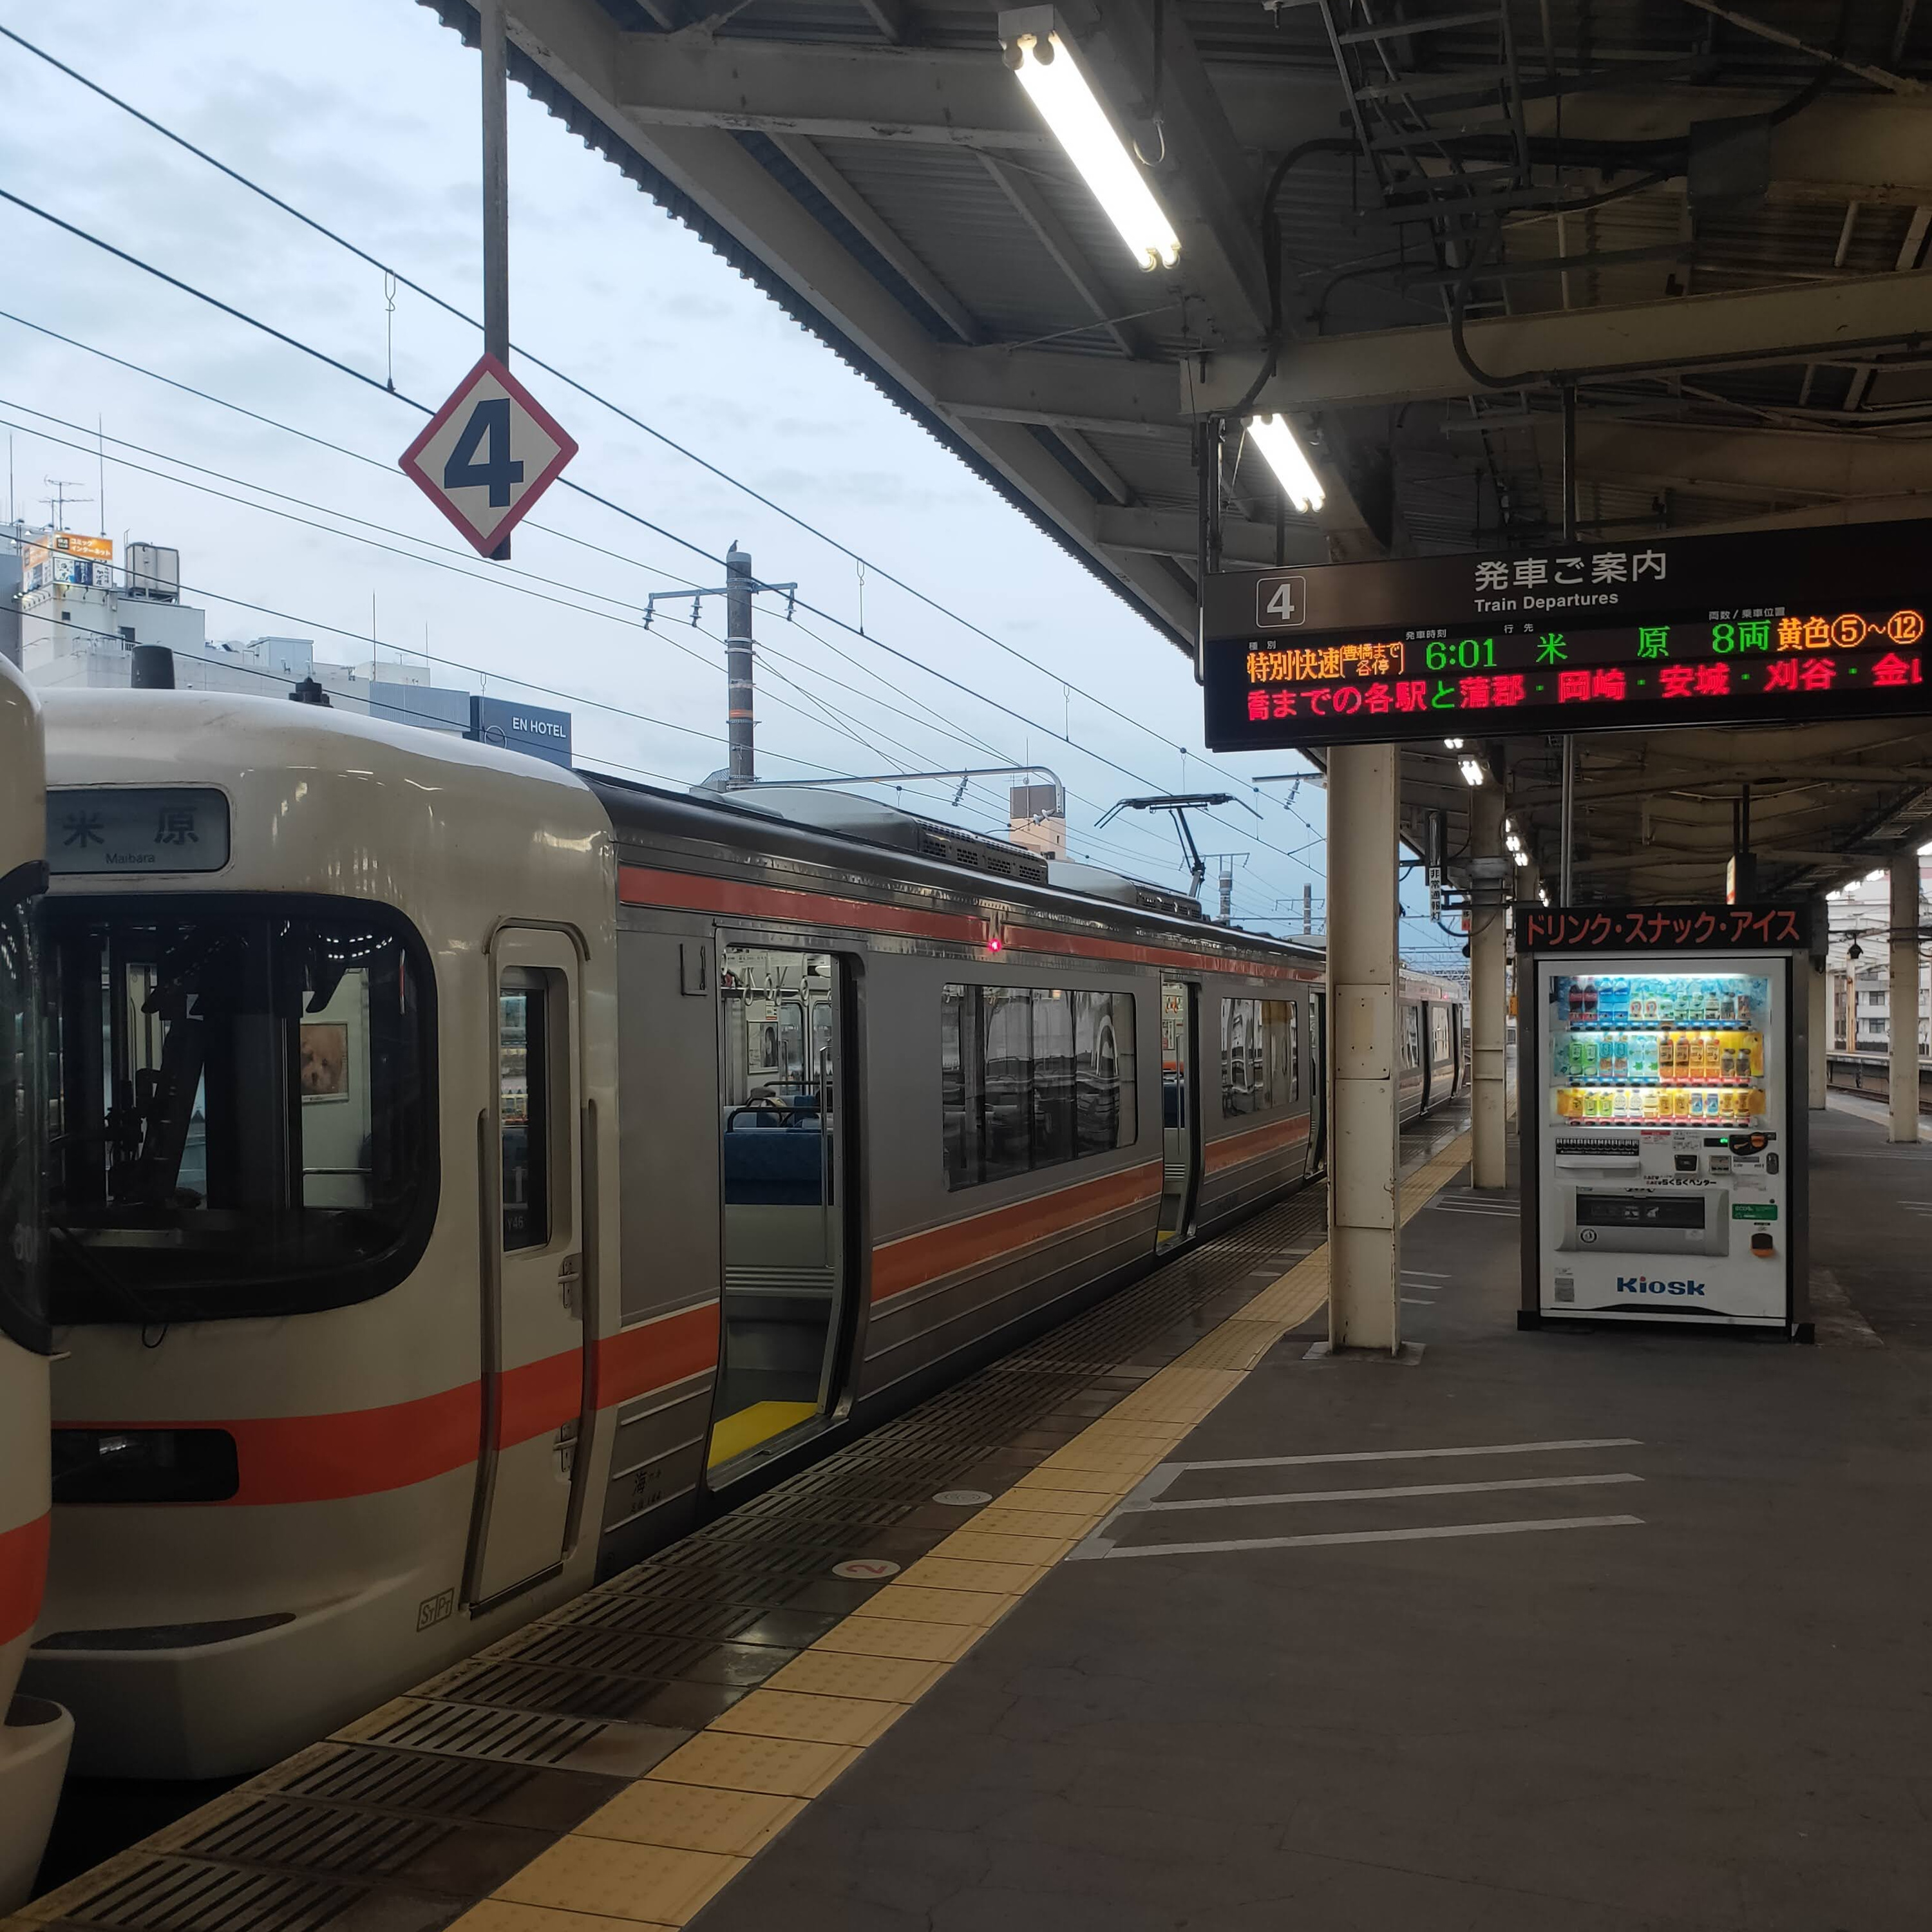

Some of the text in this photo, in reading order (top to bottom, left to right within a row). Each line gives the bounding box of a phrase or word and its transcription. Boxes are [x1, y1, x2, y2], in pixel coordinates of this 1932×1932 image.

[444, 397, 524, 508] 4
[70, 538, 93, 547] コミック
[71, 545, 111, 556] インターネット
[1473, 548, 1667, 592] 発車ご案内
[1266, 582, 1295, 620] 4
[1474, 591, 1620, 614] Train Departures
[1405, 629, 1447, 641] 発車時刻
[1247, 647, 1340, 683] 特別快速
[1426, 638, 1497, 670] 6:01
[513, 717, 567, 739] EN HOTEL
[105, 853, 155, 864] Maibara
[1528, 909, 1800, 946] ドリンク・スナック・アイス
[1616, 1276, 1705, 1296] Kiosk
